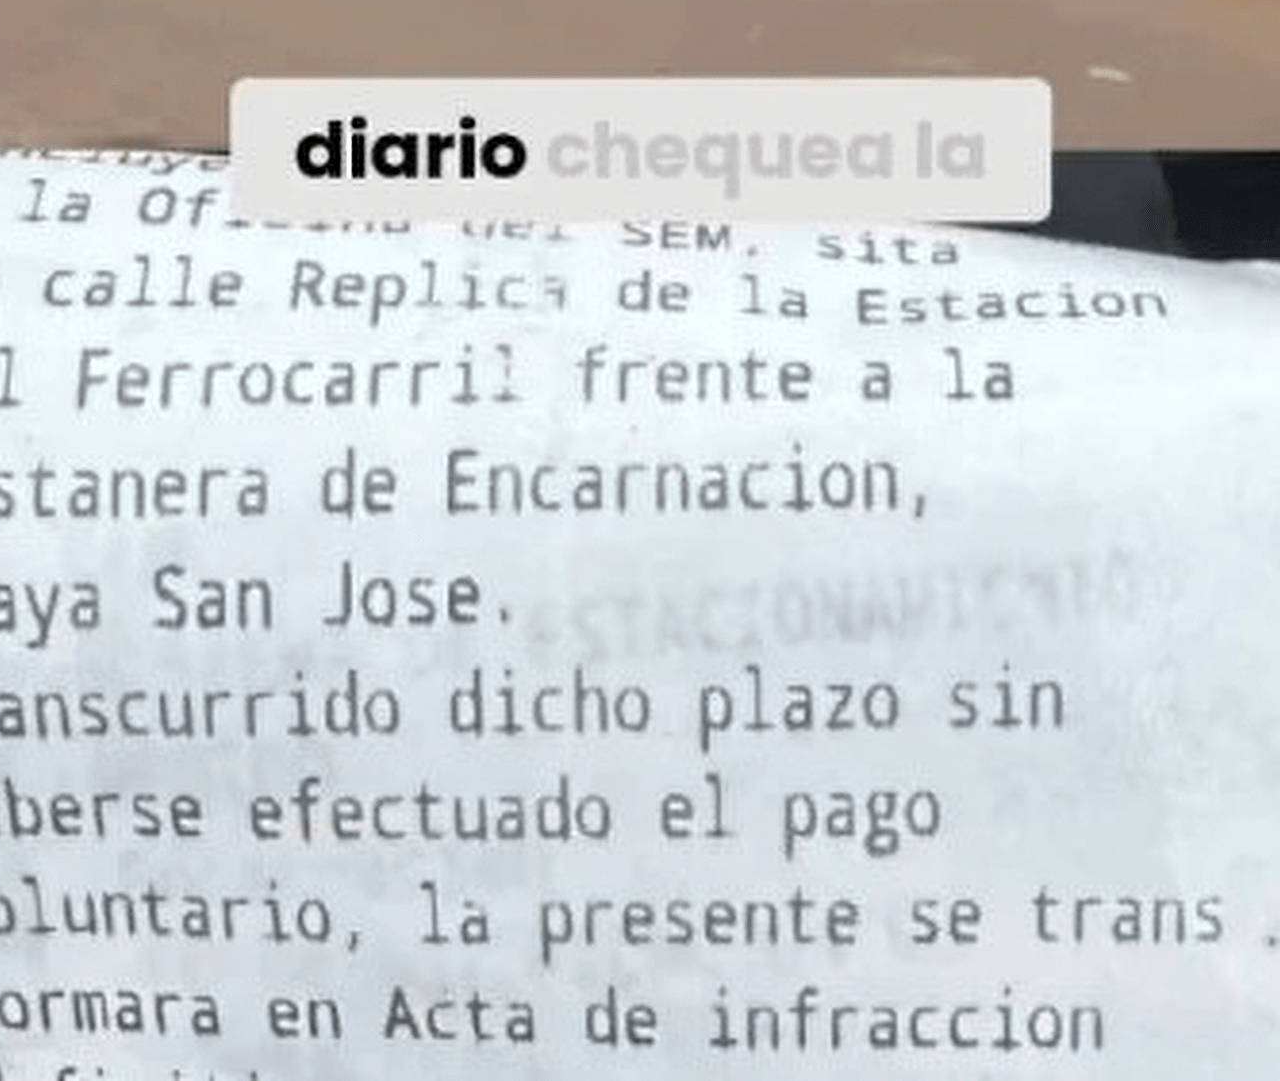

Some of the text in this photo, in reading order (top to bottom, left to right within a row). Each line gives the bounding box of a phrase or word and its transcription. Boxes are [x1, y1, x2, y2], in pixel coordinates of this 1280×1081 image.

[19, 177, 92, 225] la
[816, 231, 961, 266] sita
[42, 253, 244, 310] calle
[617, 268, 692, 313] de
[740, 272, 809, 320] la
[855, 282, 1168, 327] Estacion
[75, 342, 520, 411] Ferrocarril
[575, 343, 814, 404] frente
[860, 360, 893, 403] a
[943, 345, 1015, 402] la
[319, 445, 398, 523] de
[446, 440, 926, 519] Encarnacion,
[151, 562, 273, 633] San
[322, 558, 511, 629] Jose.
[449, 663, 652, 740] dicho
[697, 662, 901, 756] plazo
[949, 661, 1065, 731] sin
[248, 773, 613, 845] efectuado
[659, 771, 733, 841] el
[782, 789, 942, 863] pago
[419, 879, 491, 947] la
[539, 885, 862, 969] presente
[910, 898, 983, 946] se
[1031, 885, 1224, 946] trans
[266, 996, 343, 1041] en
[382, 984, 537, 1046] Acta
[584, 984, 659, 1050] de
[708, 984, 1104, 1054] infraccion
